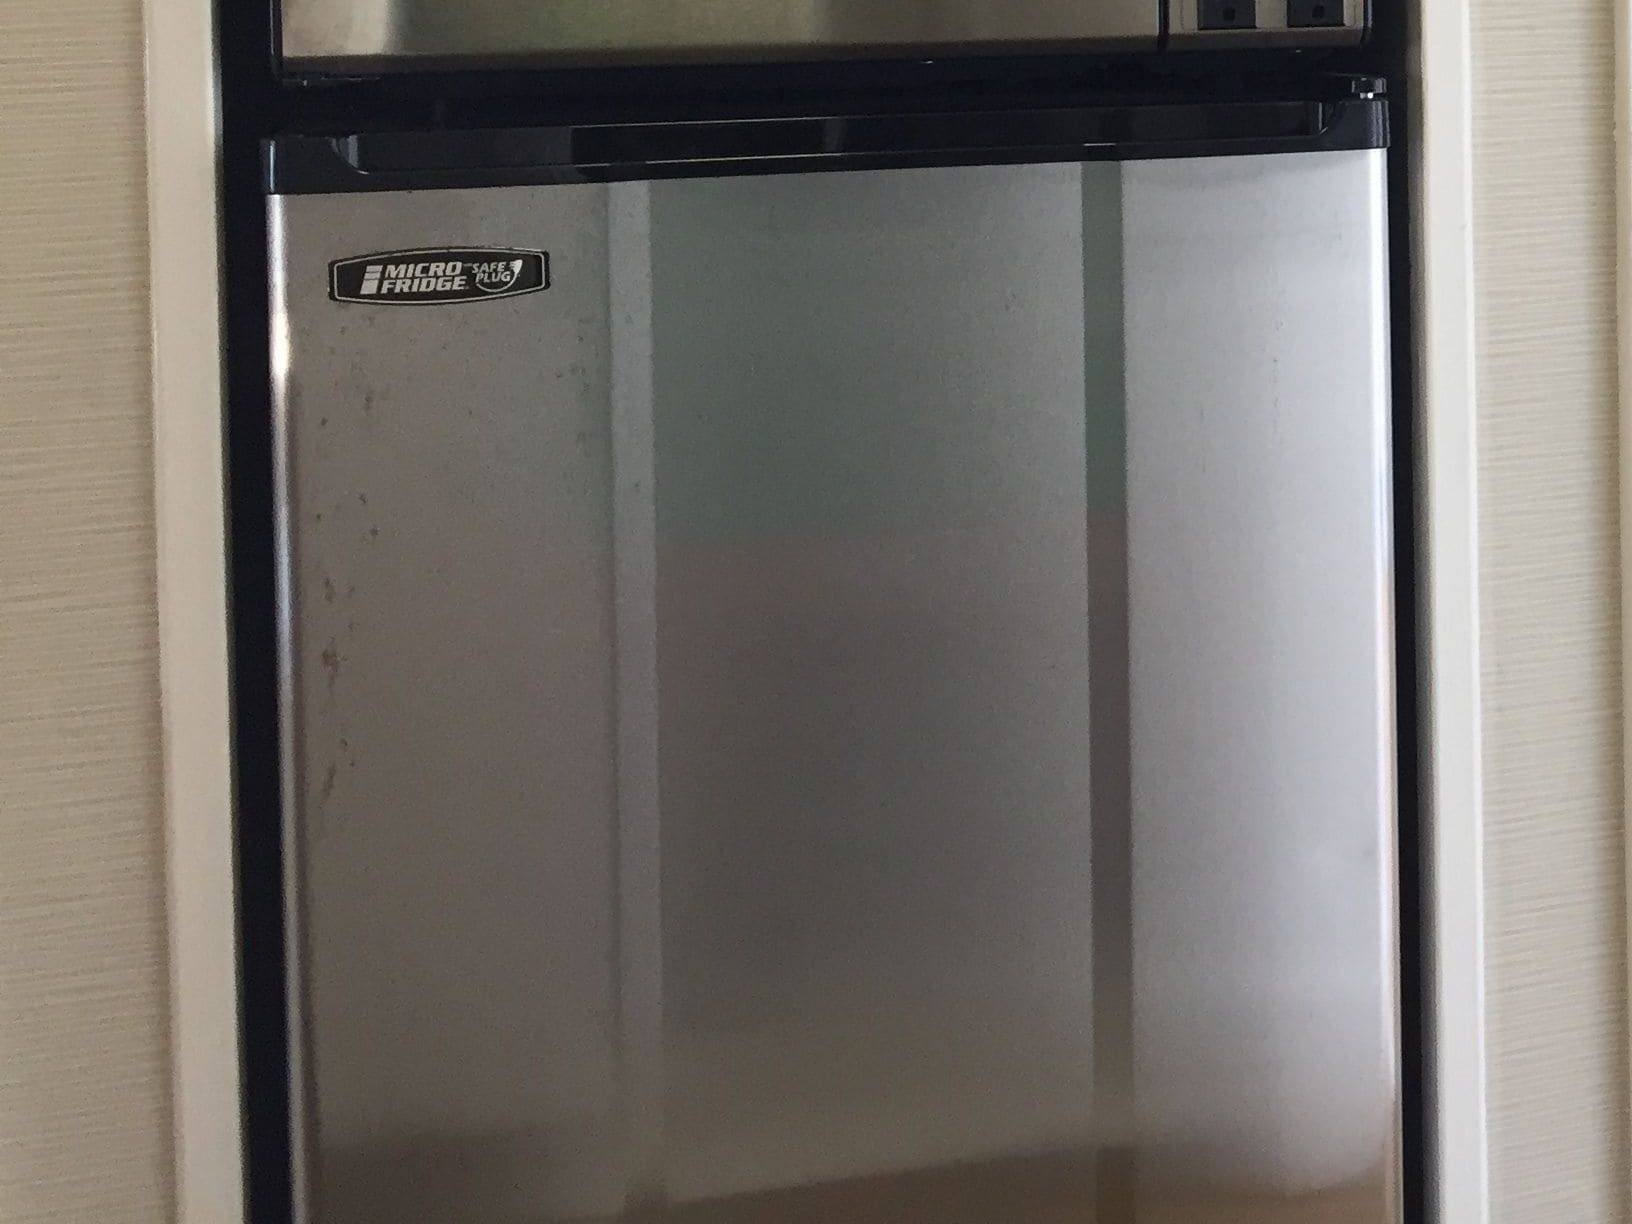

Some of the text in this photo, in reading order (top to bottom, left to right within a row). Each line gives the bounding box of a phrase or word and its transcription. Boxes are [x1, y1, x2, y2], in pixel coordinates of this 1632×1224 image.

[385, 261, 462, 277] MICRO
[472, 260, 505, 273] SAFE
[475, 271, 511, 283] PLUG
[380, 276, 468, 294] FRIDGE
